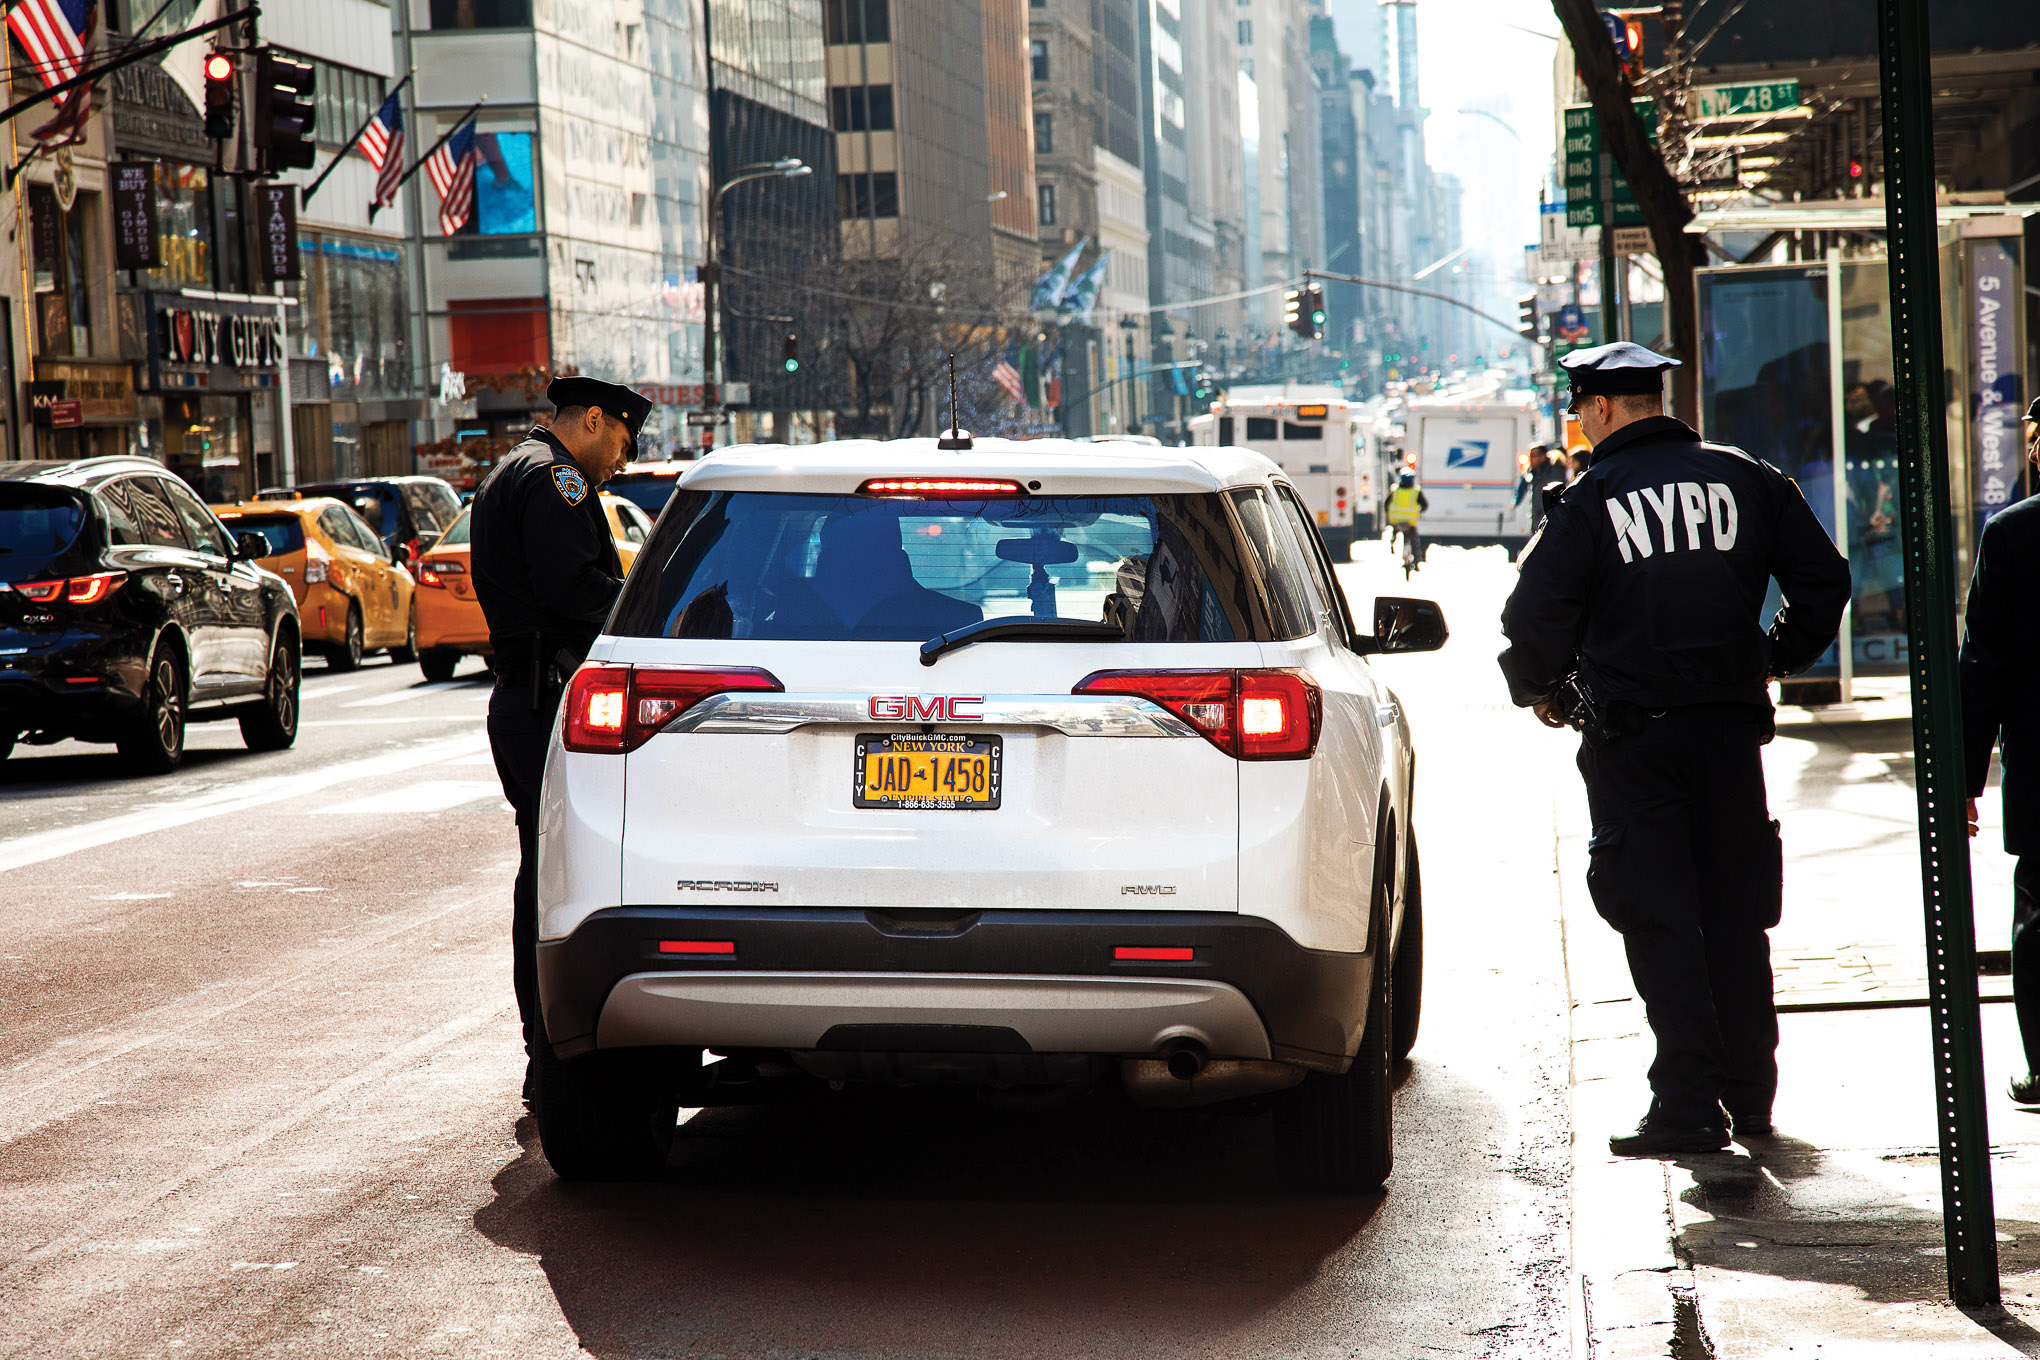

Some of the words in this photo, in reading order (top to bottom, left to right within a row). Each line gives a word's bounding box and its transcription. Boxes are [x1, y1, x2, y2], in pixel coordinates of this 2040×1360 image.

[1743, 86, 1773, 111] 48
[1777, 85, 1793, 98] ST
[1567, 111, 1590, 129] BM1
[1567, 134, 1592, 153] BM2
[121, 168, 144, 179] WE
[1568, 157, 1592, 177] BM3
[120, 180, 147, 190] BUY
[1569, 182, 1592, 202] BM4
[1569, 205, 1595, 225] BM5
[122, 210, 134, 245] GOLD
[268, 191, 288, 275] DIAMONDS
[1978, 275, 2001, 292] 5
[192, 310, 221, 364] NY
[231, 313, 283, 367] GIFTS
[1979, 296, 2001, 384] Avenue
[1981, 389, 2003, 406] &
[1982, 410, 2004, 472] West
[1984, 475, 2006, 505] 48
[1606, 482, 1738, 564] NYPD
[23, 614, 54, 624] QX60
[868, 694, 986, 721] GMC
[890, 733, 966, 742] CityBuickGMC.com
[892, 742, 926, 752] NEW
[930, 742, 966, 752] YORK
[855, 745, 865, 797] CITY
[870, 755, 911, 791] JAD
[930, 755, 985, 792] 1458
[990, 746, 1000, 798] CITY
[897, 800, 956, 809] 1-866-635-3555
[677, 880, 779, 892] ACADIA
[1121, 885, 1177, 895] AWD
